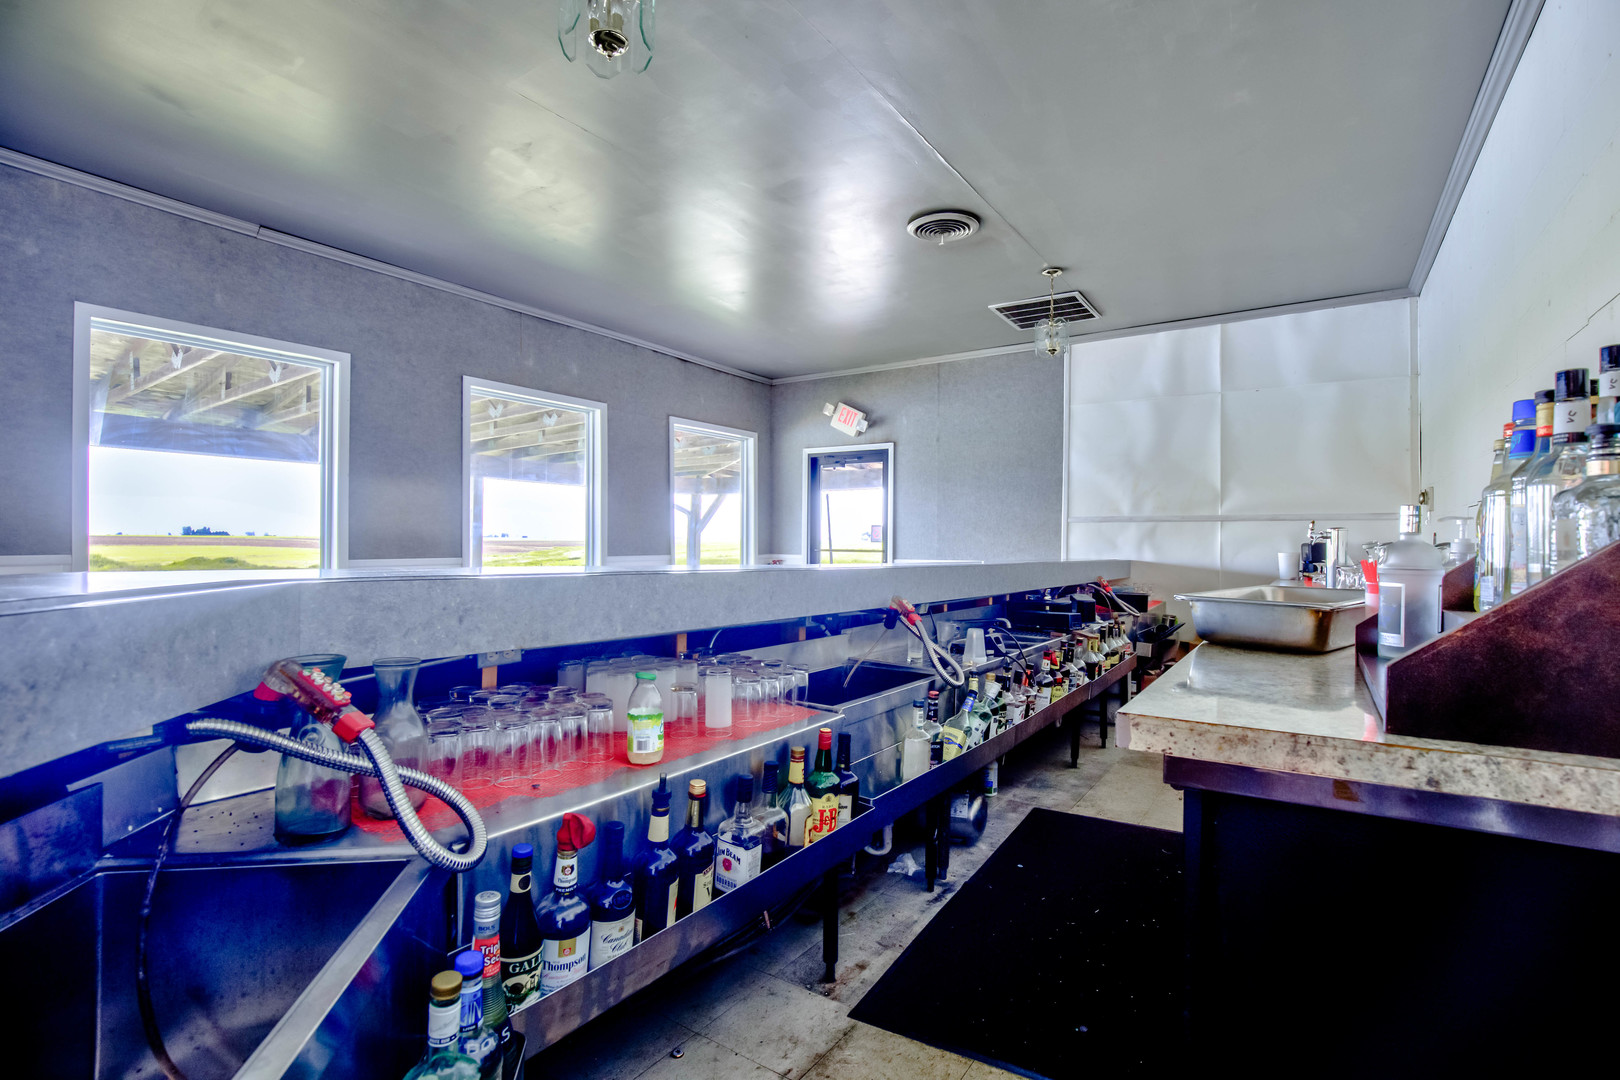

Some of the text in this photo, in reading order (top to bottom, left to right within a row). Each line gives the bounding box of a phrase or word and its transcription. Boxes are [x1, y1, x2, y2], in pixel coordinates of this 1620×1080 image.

[837, 405, 859, 428] EXIT
[725, 847, 741, 866] BEAM
[478, 924, 497, 932] BOLS
[480, 940, 500, 955] Tripl
[542, 952, 587, 973] Thompson
